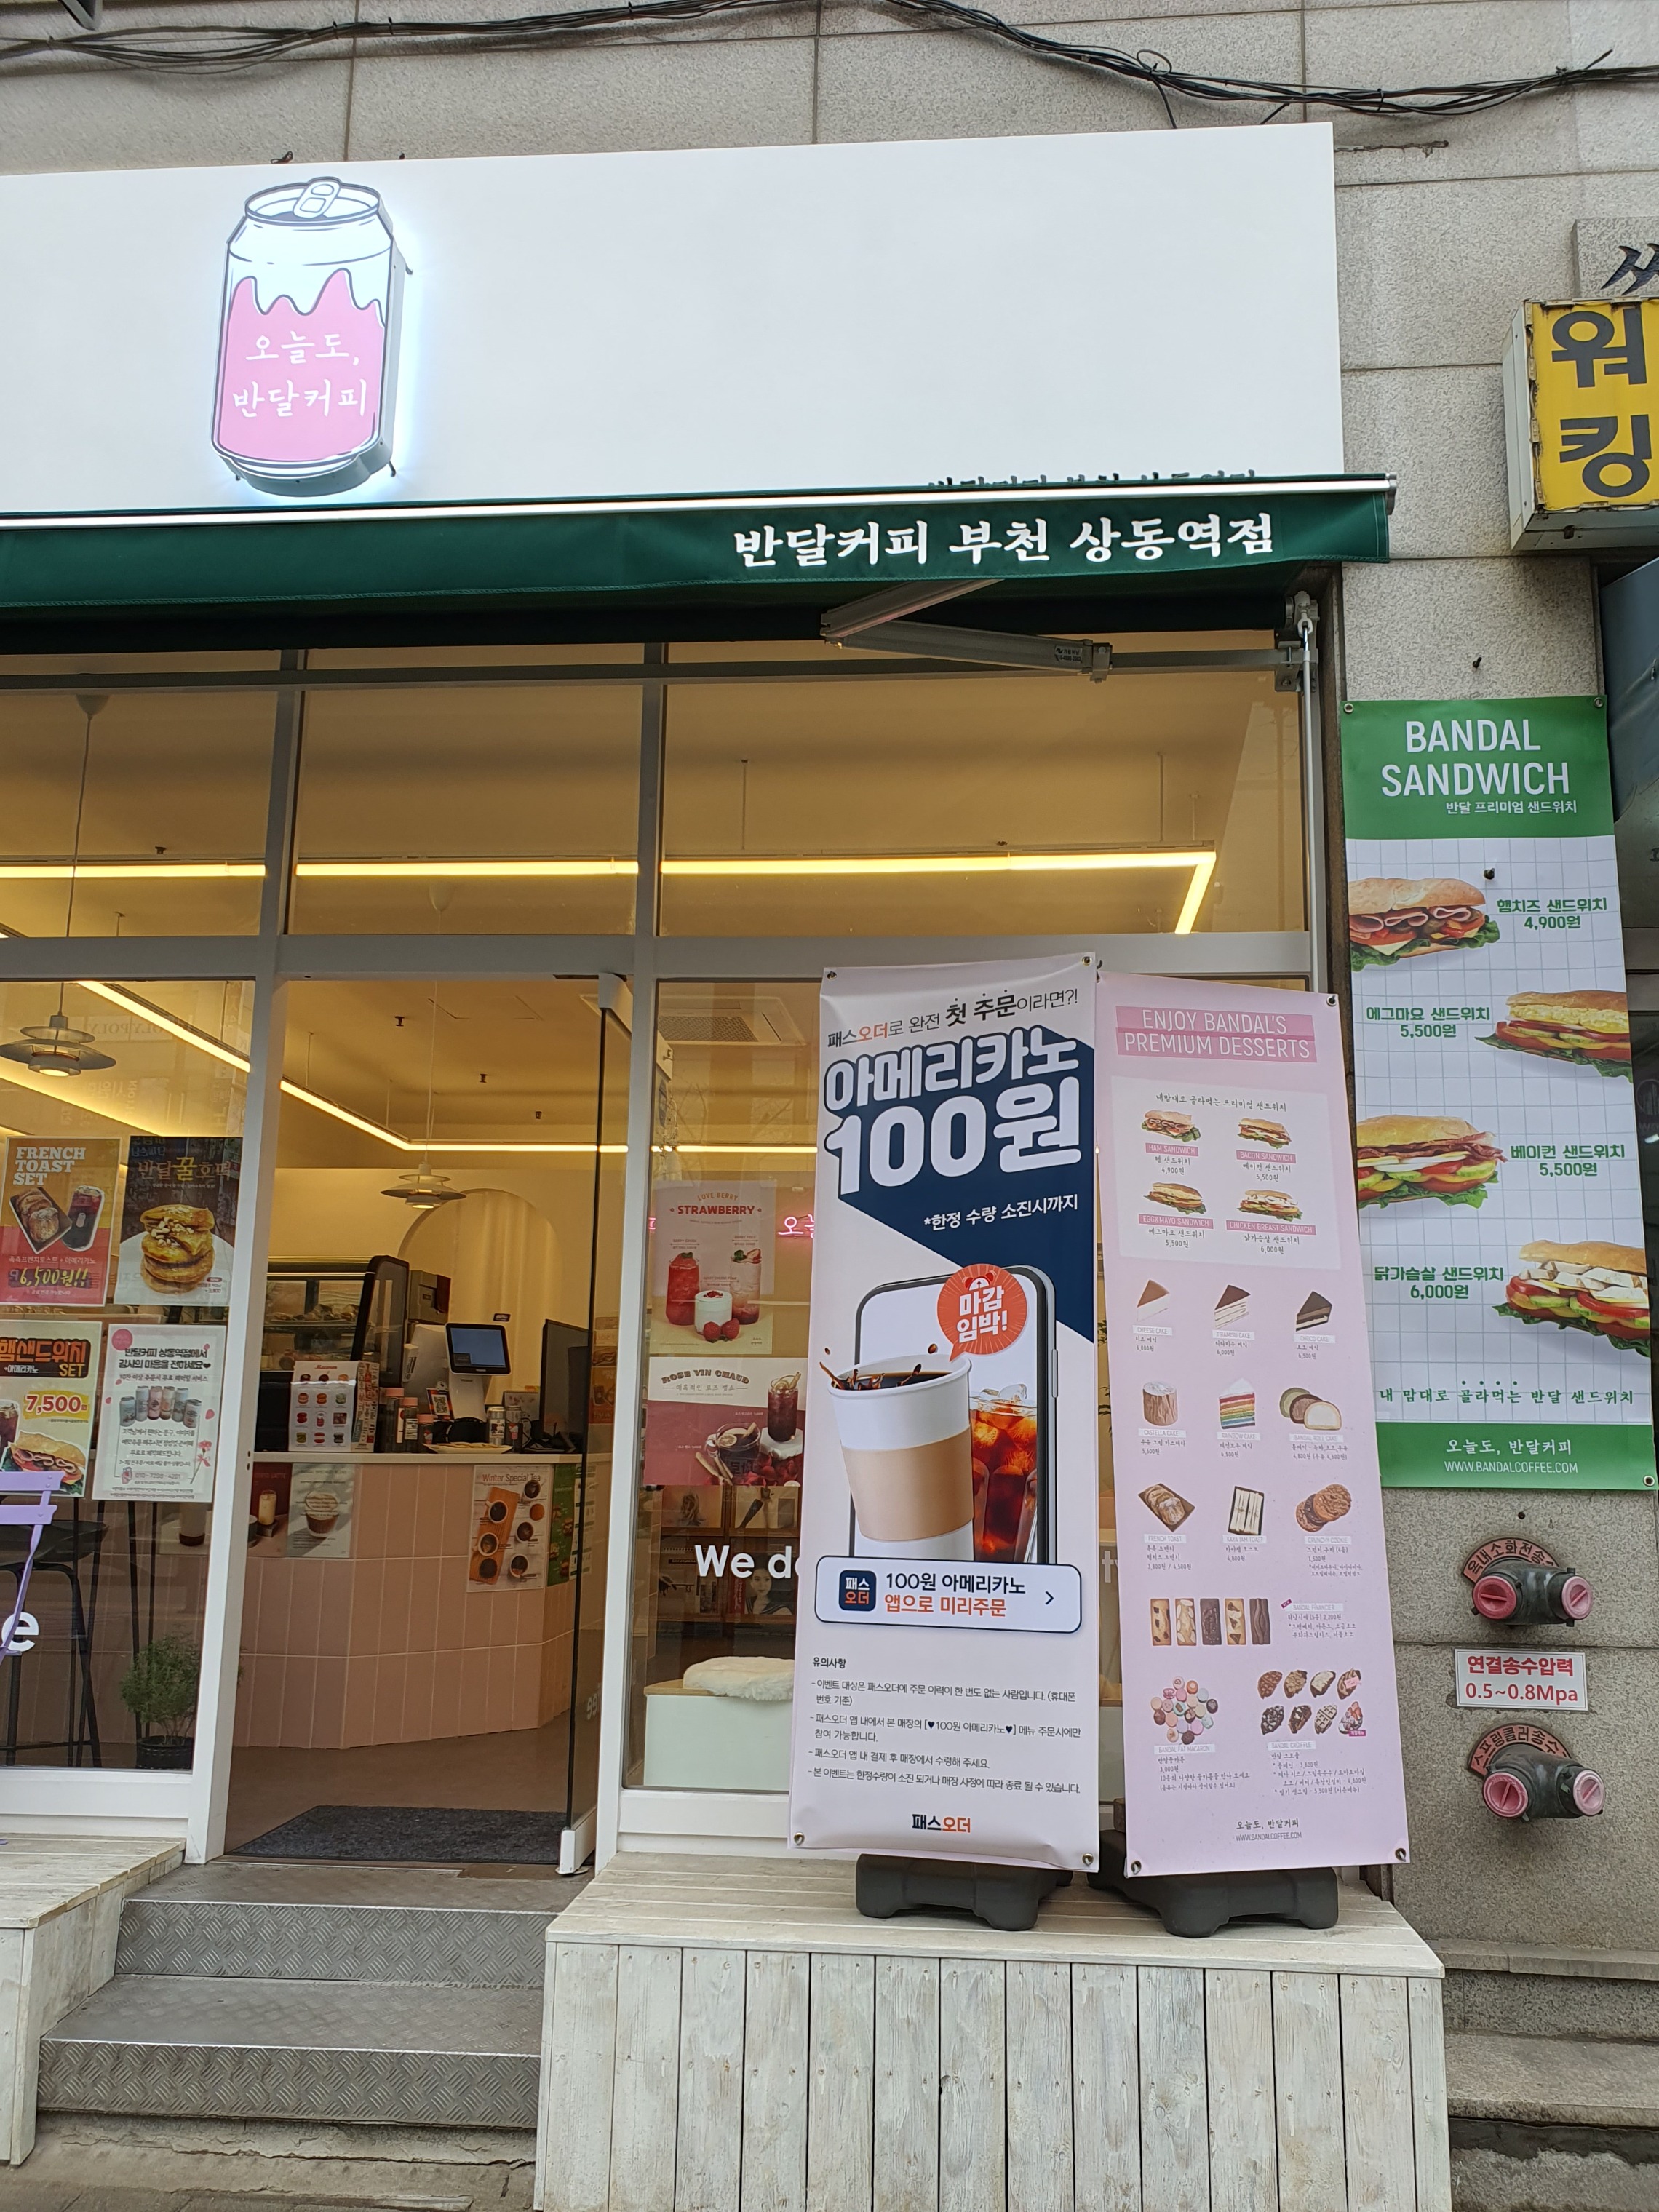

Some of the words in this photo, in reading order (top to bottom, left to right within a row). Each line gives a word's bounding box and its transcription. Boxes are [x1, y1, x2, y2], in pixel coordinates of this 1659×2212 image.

[246, 331, 359, 366] 오늘도,
[233, 379, 367, 417] 반달커피
[734, 520, 928, 567] 반달커피
[949, 518, 1050, 565] 부천
[1070, 513, 1273, 562] 상동역점
[1406, 719, 1540, 753] BANDAL
[1382, 762, 1570, 797] SANDWICH
[1446, 801, 1471, 815] 반달
[1475, 800, 1524, 814] 프리미엄
[1527, 800, 1577, 813] 샌드위치
[1496, 899, 1541, 914] 햄치즈
[1547, 897, 1607, 912] 샌드위치
[1524, 915, 1580, 930] 4,900원
[827, 1020, 904, 1048] 패스오더로
[908, 1013, 940, 1033] 완전
[945, 1003, 967, 1027] 첫
[973, 988, 1078, 1021] 주문이라면?!
[1366, 1007, 1425, 1022] 에그마요
[1431, 1006, 1490, 1021] 샌드위치
[1142, 1009, 1197, 1032] ENJOY
[1204, 1012, 1287, 1035] BANDAL'S
[1400, 1024, 1457, 1039] 5,500원
[1124, 1033, 1212, 1054] PREMIUM
[1220, 1036, 1310, 1059] DESSERTS
[824, 1025, 1080, 1111] 아메리카노
[1155, 1093, 1187, 1104] 내맘대로
[1189, 1095, 1221, 1107] 골라먹는
[1222, 1099, 1253, 1110] 프리미엄
[1256, 1102, 1287, 1112] 샌드위치
[825, 1076, 1082, 1195] 100원
[16, 1147, 86, 1160] FRENCH
[1164, 1146, 1195, 1155] SANDWICH
[1240, 1151, 1260, 1160] BACON
[1261, 1153, 1292, 1161] SANDWICH
[1511, 1144, 1556, 1160] 베이컨
[1562, 1144, 1625, 1159] 샌드위치
[15, 1160, 75, 1173] TOAST
[1164, 1157, 1190, 1166] 샌드위치
[1265, 1164, 1291, 1173] 샌드위치
[1161, 1166, 1185, 1176] 4,900원
[1539, 1162, 1598, 1177] 5,500원
[13, 1173, 47, 1185] SET
[1256, 1173, 1278, 1182] 5,500원
[697, 1193, 714, 1201] LOVE
[717, 1193, 739, 1201] BERRY
[677, 1206, 755, 1214] STRAWBERRY
[966, 1206, 996, 1225] 수량
[1000, 1193, 1078, 1220] 소진시까지
[1143, 1216, 1176, 1225] EGG&MAYO
[1177, 1218, 1209, 1227] SANDWICH
[1230, 1221, 1255, 1230] CHICKEN
[1257, 1223, 1278, 1231] BREAST
[1281, 1225, 1313, 1233] SANDWICH
[1178, 1229, 1205, 1238] 샌드위치
[1273, 1236, 1300, 1245] 샌드위치
[1166, 1239, 1189, 1248] 5,500원
[1261, 1246, 1284, 1254] 6,000원
[65, 1257, 96, 1265] 아메리카노
[1374, 1266, 1436, 1281] 닭가슴살
[1441, 1266, 1504, 1281] 샌드위치
[1410, 1284, 1469, 1300] 6,000원
[960, 1286, 1004, 1315] 마감
[956, 1315, 1008, 1343] 임박!
[0, 1339, 87, 1363] 햄샌드위치
[59, 1363, 85, 1377] SET
[661, 1371, 691, 1384] ROSE
[715, 1370, 749, 1384] CHAUD
[1379, 1389, 1393, 1404] 내
[1403, 1388, 1451, 1404] 맘대로
[1457, 1389, 1523, 1404] 골라먹는
[1531, 1390, 1562, 1404] 반달
[1571, 1390, 1634, 1405] 샌드위치
[1446, 1439, 1500, 1456] 오늘도,
[1508, 1440, 1572, 1455] 반달커피
[1444, 1460, 1578, 1474] WWW.BANDALCOFFEE.COM
[482, 1473, 504, 1482] Winter
[506, 1473, 528, 1484] Special
[530, 1473, 541, 1481] Tea
[695, 1545, 755, 1578] We
[768, 1545, 801, 1578] d
[845, 1576, 870, 1591] 패스
[886, 1572, 936, 1591] 100원
[942, 1574, 1026, 1594] 아메리카노
[845, 1591, 870, 1605] 오더
[884, 1594, 934, 1613] 앱으로
[940, 1596, 1007, 1617] 미리주문
[813, 1657, 846, 1669] 유의사항
[1467, 1655, 1573, 1677] 연결송수압력
[842, 1682, 866, 1692] 대상은
[867, 1683, 907, 1693] 패스오더에
[910, 1684, 926, 1694] 주문
[928, 1686, 952, 1695] 이력이
[955, 1687, 963, 1697] 한
[965, 1687, 982, 1698] 번도
[984, 1688, 1000, 1699] 없는
[1002, 1689, 1046, 1701] 사람입니다.
[1047, 1691, 1076, 1702] (휴대폰
[1465, 1682, 1578, 1705] 0.5~0.8Mpa
[816, 1695, 831, 1704] 번호
[834, 1696, 853, 1706] 기준)
[849, 1716, 858, 1726] 앱
[860, 1717, 885, 1727] 내에서
[887, 1718, 895, 1728] 본
[897, 1718, 922, 1729] 매장의
[1019, 1726, 1036, 1736] 메뉴
[1038, 1727, 1081, 1738] 주문시에만
[815, 1729, 831, 1739] 참여
[834, 1730, 878, 1742] 가능합니다.
[848, 1750, 857, 1760] 앱
[859, 1751, 868, 1761] 내
[870, 1751, 887, 1762] 결제
[889, 1753, 898, 1763] 후
[900, 1754, 934, 1765] 매장에서
[935, 1755, 960, 1767] 수령해
[823, 1768, 854, 1780] 이벤트는
[856, 1770, 896, 1783] 한정수량이
[897, 1773, 914, 1783] 소진
[916, 1773, 940, 1786] 되거나
[942, 1775, 958, 1786] 매장
[960, 1777, 985, 1789] 사정에
[987, 1778, 1004, 1789] 따라
[1006, 1780, 1022, 1791] 종료
[1024, 1781, 1033, 1792] 될
[1035, 1782, 1043, 1792] 수
[1045, 1783, 1081, 1794] 있습니다.
[912, 1813, 971, 1833] 패스오더
[1236, 1820, 1264, 1831] 오늘도,
[1268, 1818, 1300, 1830] 반달커피
[1236, 1831, 1302, 1842] WWW.BANDALCOFFEE.COM
